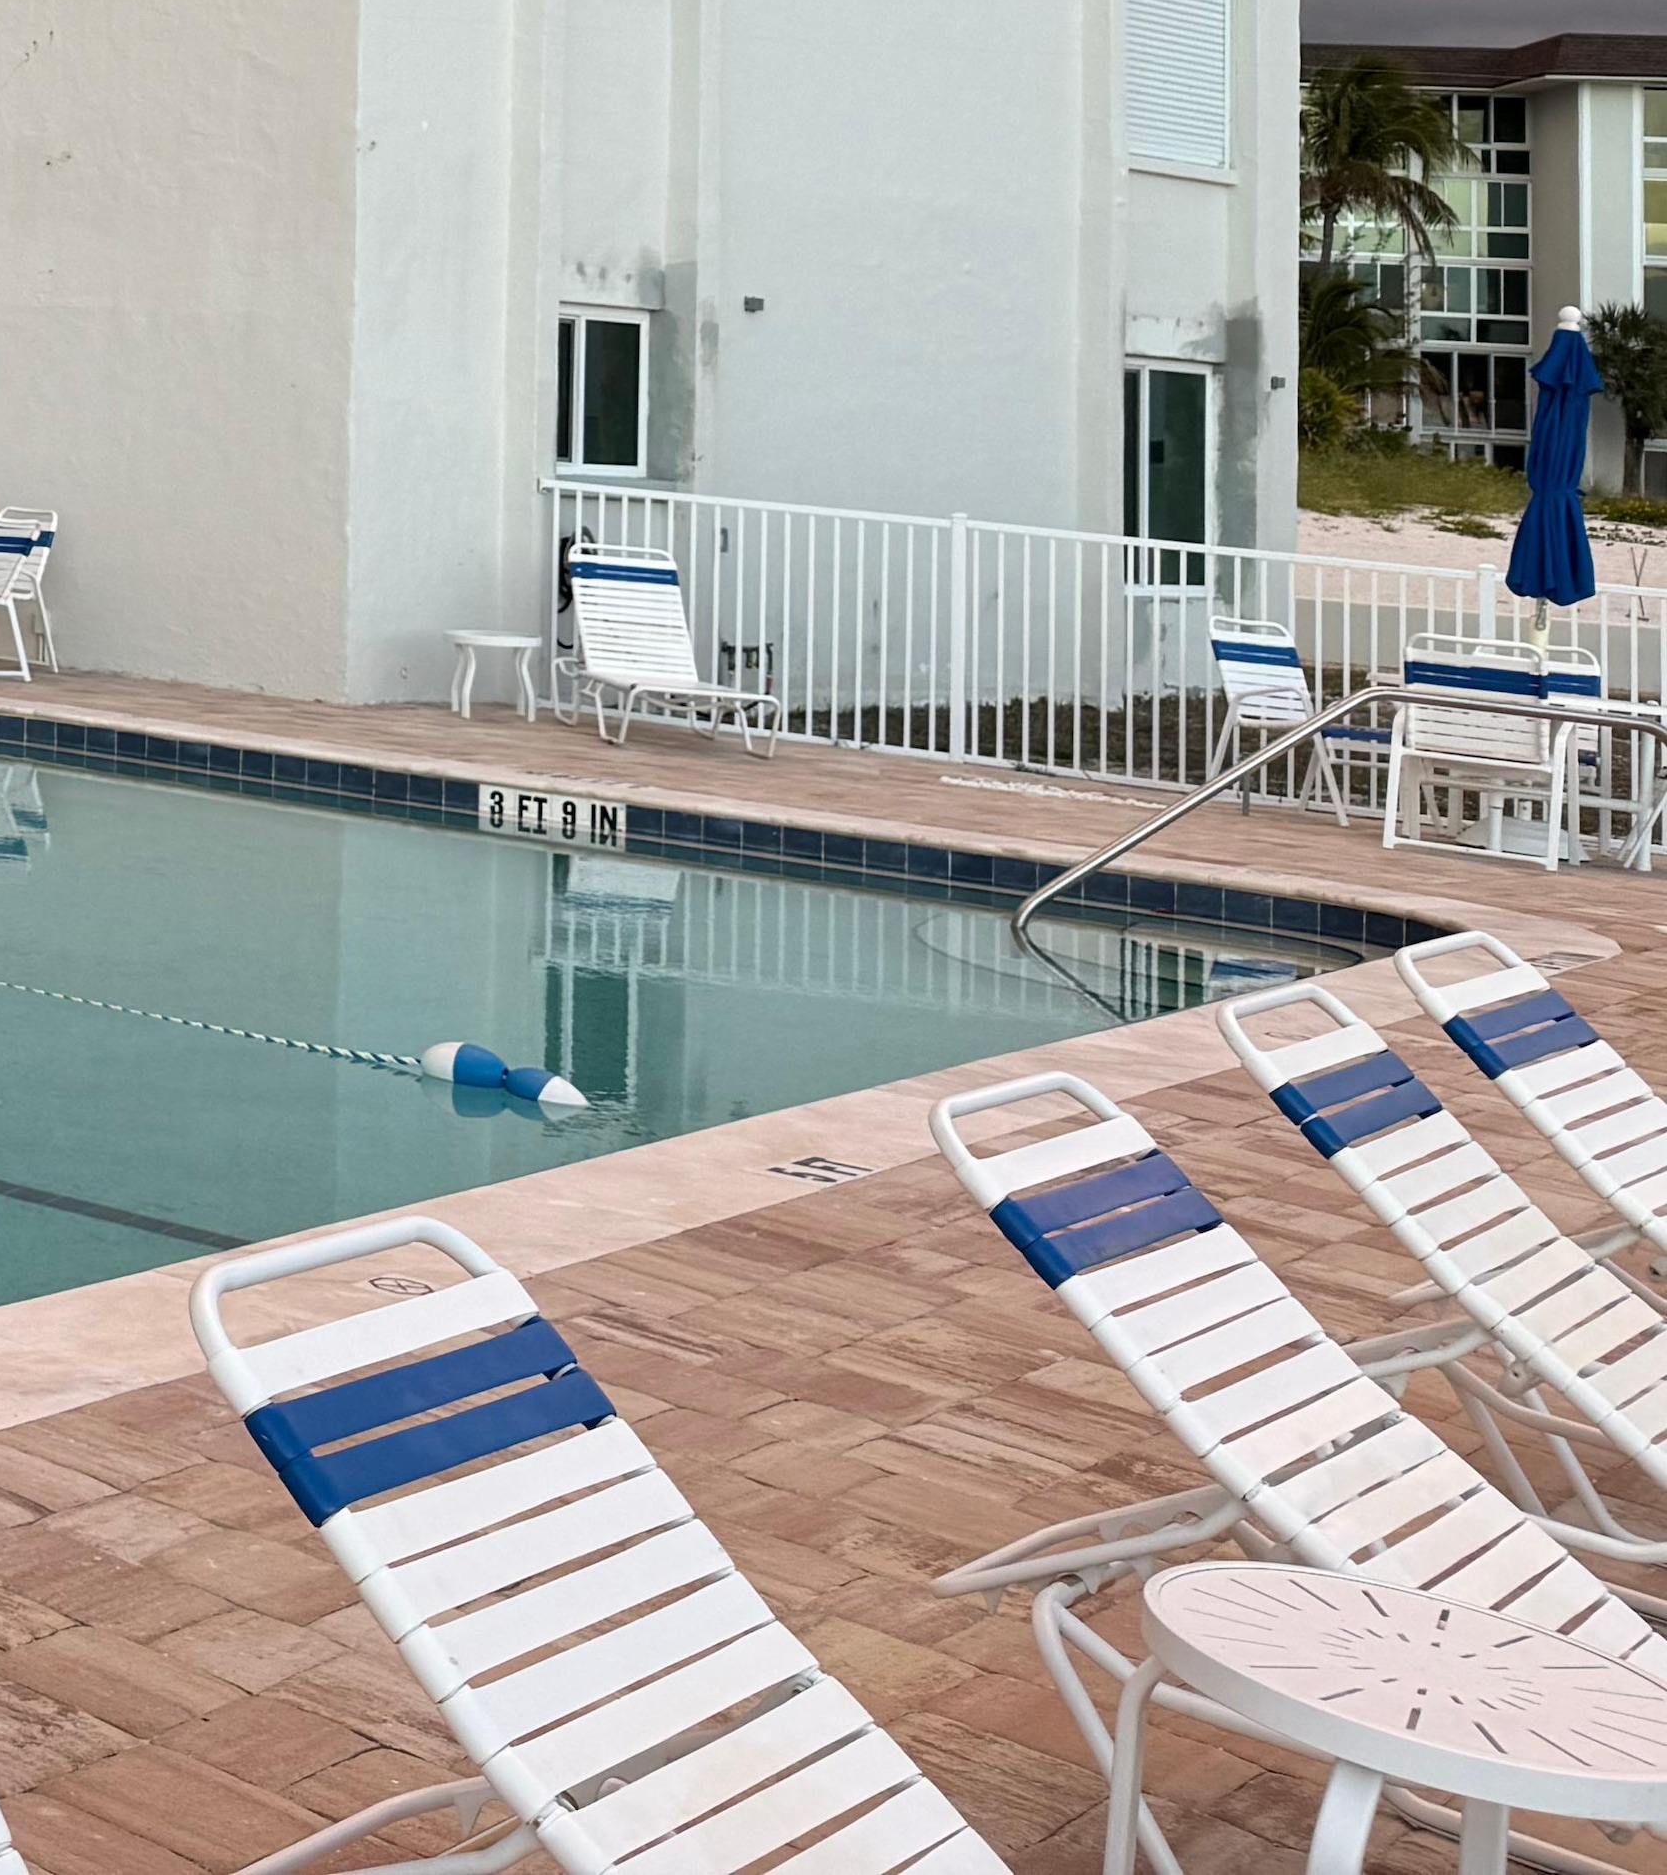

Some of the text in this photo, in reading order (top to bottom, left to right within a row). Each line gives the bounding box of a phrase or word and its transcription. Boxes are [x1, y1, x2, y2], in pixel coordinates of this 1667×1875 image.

[489, 790, 504, 815] 3
[562, 801, 577, 825] 9
[766, 1156, 874, 1183] 5 FT
